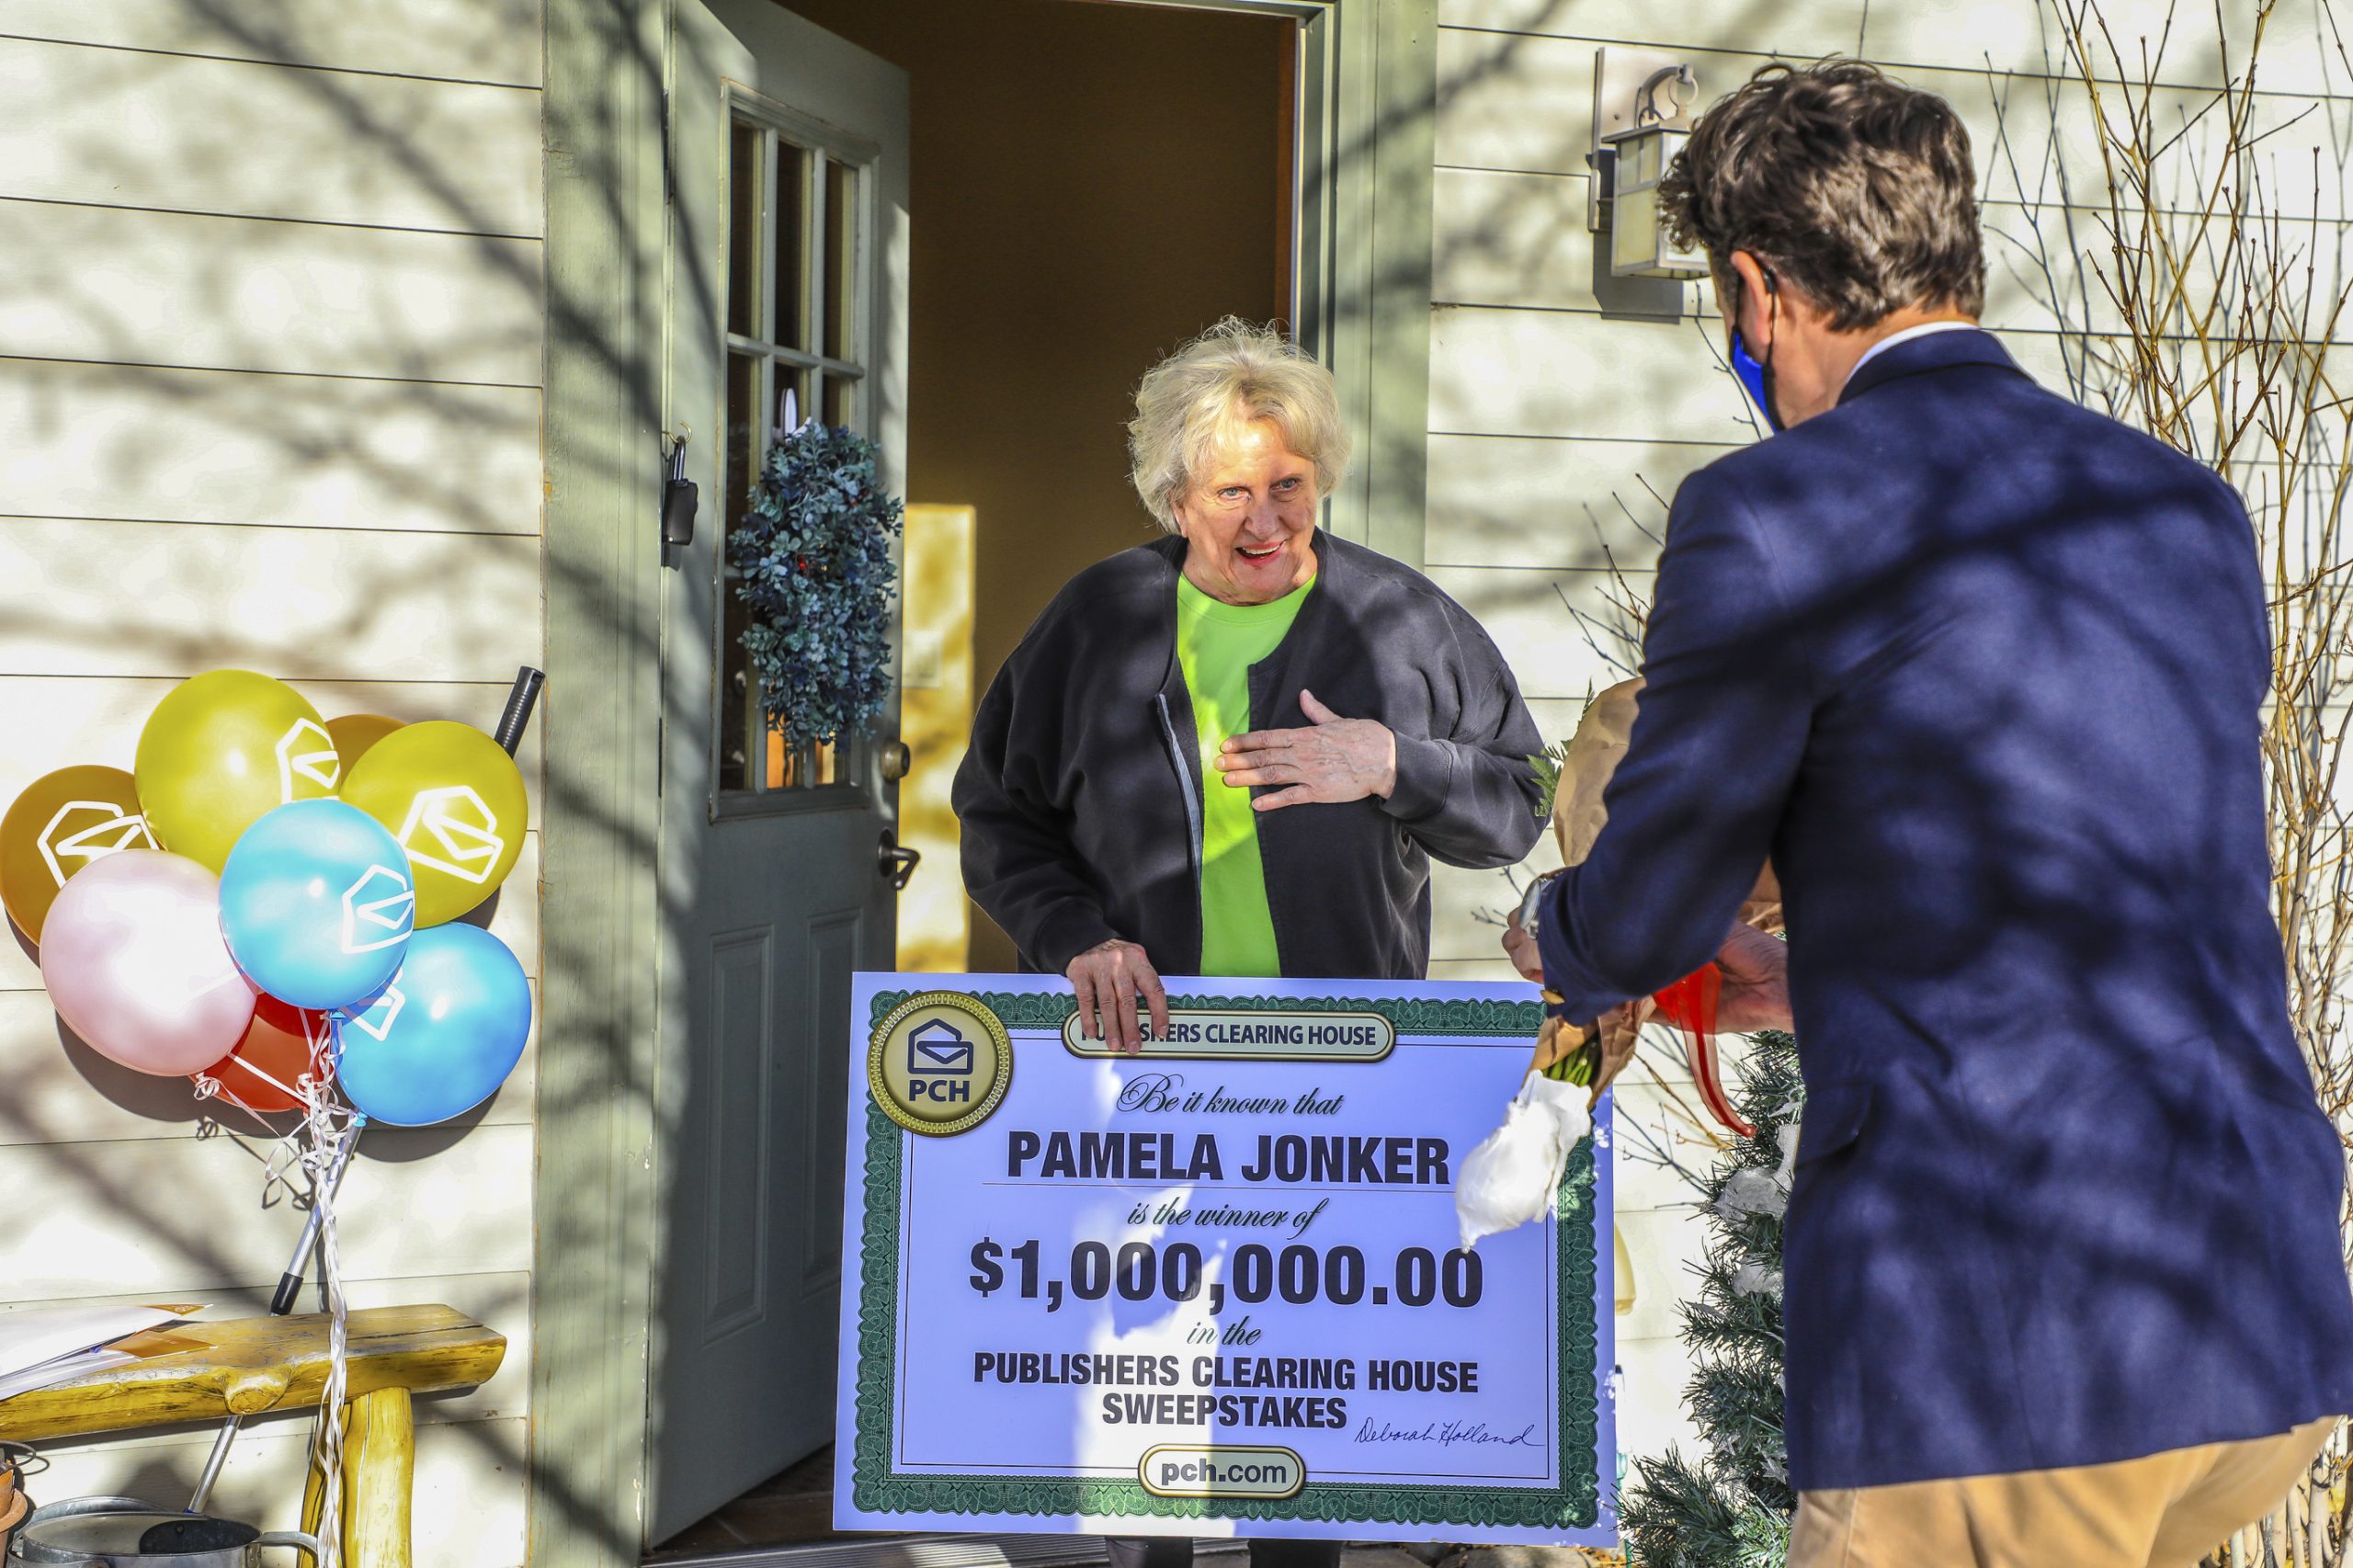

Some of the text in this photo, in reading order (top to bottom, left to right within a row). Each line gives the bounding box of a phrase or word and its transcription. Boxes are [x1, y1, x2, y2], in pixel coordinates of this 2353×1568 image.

[1201, 1023, 1303, 1045] CLEARING
[1308, 1025, 1376, 1046] HOUSE
[909, 1079, 970, 1102] PCH
[1117, 1073, 1344, 1115] Be it known that
[1007, 1131, 1450, 1185] PAMELA JONKER
[1127, 1197, 1330, 1240] is the winner of
[969, 1236, 1483, 1315] $1,000,000.00
[1187, 1316, 1262, 1346] in the
[974, 1352, 1479, 1392] PUBLISHERS CLEARING HOUSE
[1102, 1393, 1347, 1428] SWEEPSTAKES
[1354, 1416, 1546, 1447] Deborah Holland
[1162, 1458, 1286, 1485] pch.com
